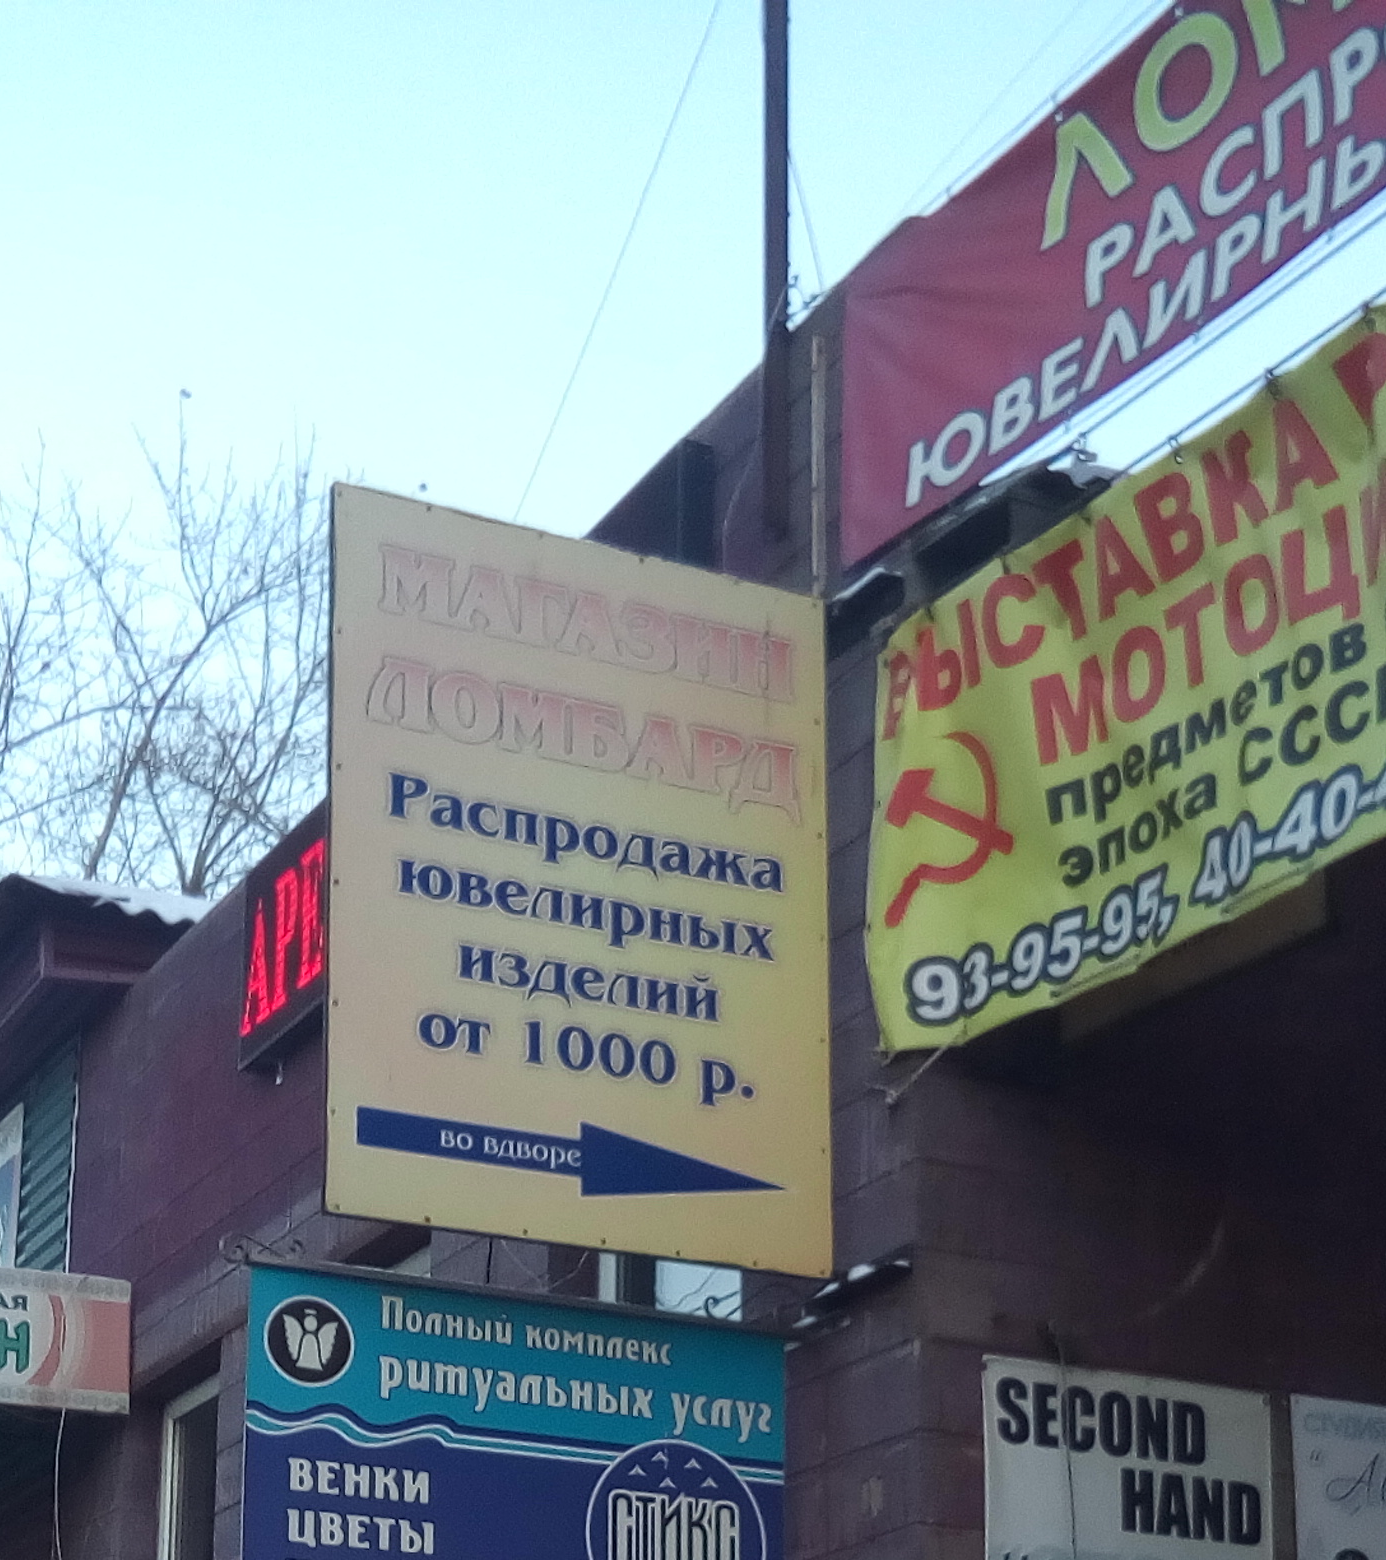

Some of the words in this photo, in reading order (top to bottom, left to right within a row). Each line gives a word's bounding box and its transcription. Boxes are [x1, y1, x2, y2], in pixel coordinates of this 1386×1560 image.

[882, 400, 1340, 742] ВЫСТАВКА
[378, 543, 796, 702] МАГАЗИН
[366, 655, 801, 825] ЛОМБАРД
[1045, 622, 1367, 826] предметов
[387, 771, 785, 894] Распродажа
[1056, 772, 1217, 887] эпоха
[397, 858, 776, 962] ювелирных
[457, 942, 720, 1023] изделий
[418, 1011, 492, 1056] от
[524, 1019, 677, 1087] 1000
[699, 1057, 757, 1106] р.
[440, 1128, 473, 1152] во
[483, 1134, 583, 1169] вдворе
[379, 1294, 513, 1347] Полный
[524, 1322, 673, 1367] комплекс
[378, 1354, 654, 1420] ритуальных
[670, 1391, 773, 1443] услуг
[995, 1376, 1207, 1467] SECOND
[287, 1455, 431, 1505] ВЕНКИ
[1120, 1466, 1263, 1547] HAND
[286, 1507, 435, 1556] ЦВЕТЫ
